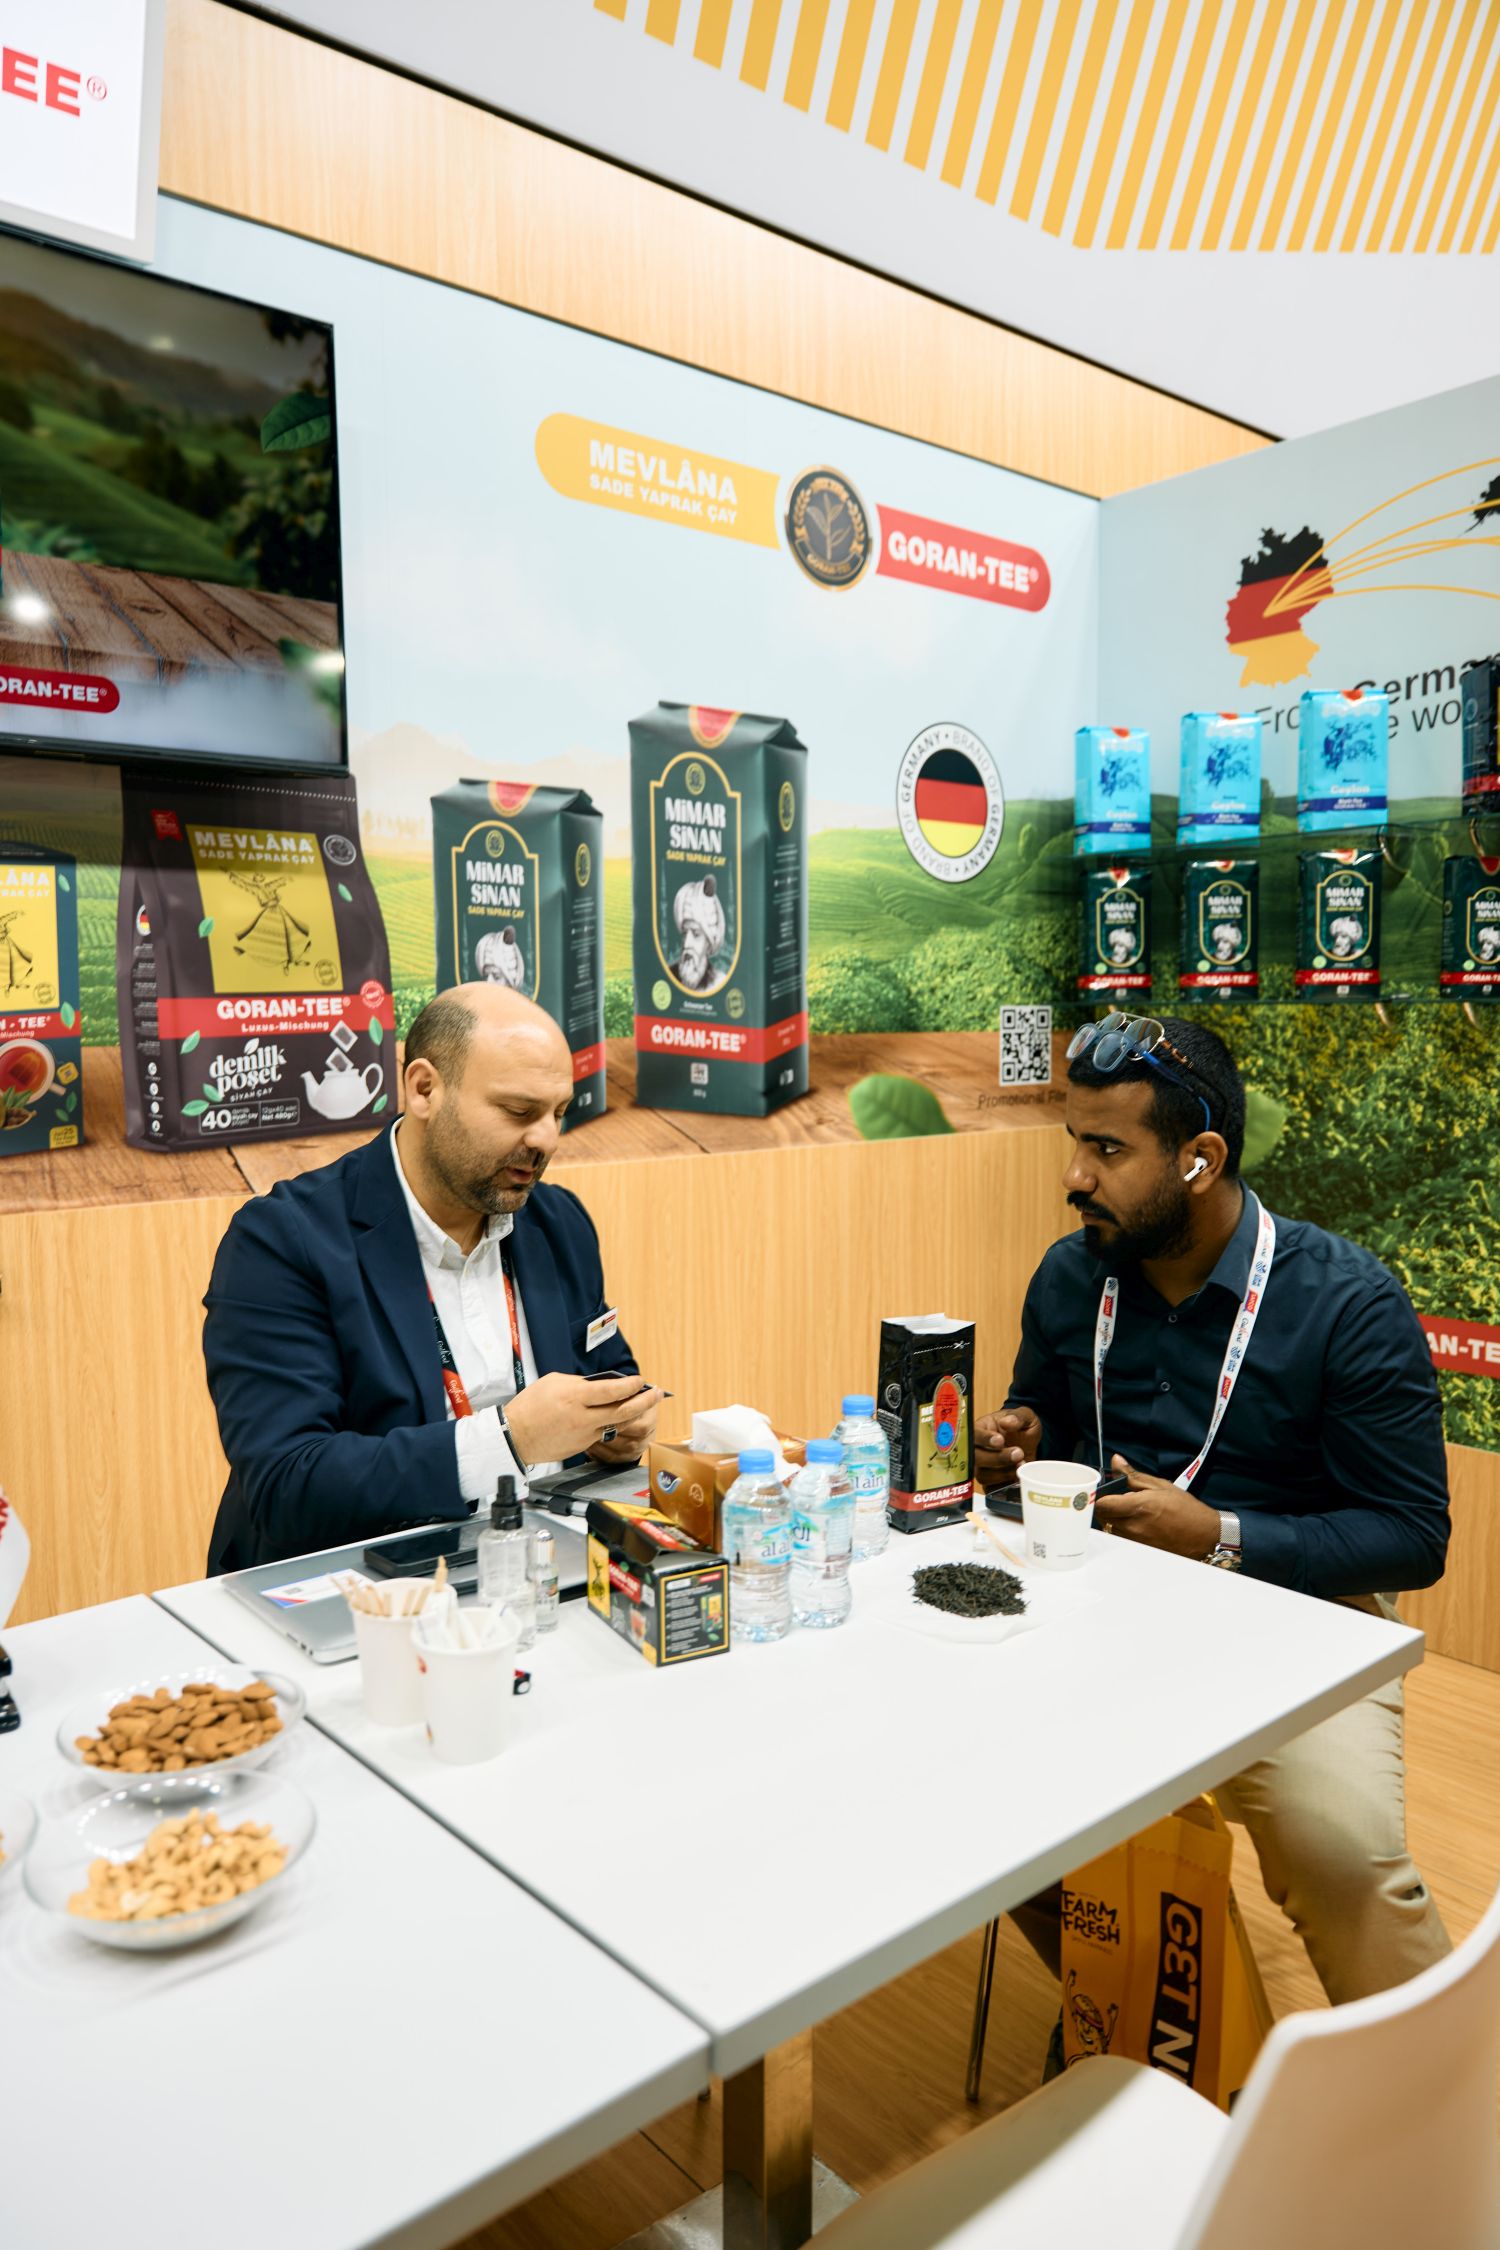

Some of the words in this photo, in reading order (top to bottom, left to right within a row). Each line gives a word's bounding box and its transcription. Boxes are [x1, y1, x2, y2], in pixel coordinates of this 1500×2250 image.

[590, 438, 737, 505] MEVLÂNA
[590, 473, 634, 498] SADE
[639, 485, 704, 516] YAPRAK
[707, 504, 738, 526] ÇAY
[1254, 705, 1299, 734] Fro
[902, 731, 941, 804] GERMANY
[953, 730, 990, 772] BRAND
[987, 775, 999, 797] OF
[902, 810, 915, 833] OF
[194, 831, 313, 853] MEVLÂNA
[964, 804, 1000, 874] GERMANY
[199, 849, 235, 860] SADE
[239, 851, 289, 863] YAPRAK
[291, 855, 316, 865] ÇAY
[912, 836, 950, 876] BRAND
[241, 1020, 330, 1033] Luxus-Mischung
[209, 1045, 287, 1078] demlik
[201, 1109, 232, 1129] 40
[1426, 1331, 1500, 1364] AN-TE
[862, 1473, 885, 1489] ain
[1061, 1890, 1118, 1925] FARM
[1061, 1911, 1120, 1945] FRESH
[1161, 1902, 1199, 2022] GET
[1152, 2019, 1195, 2085] N
